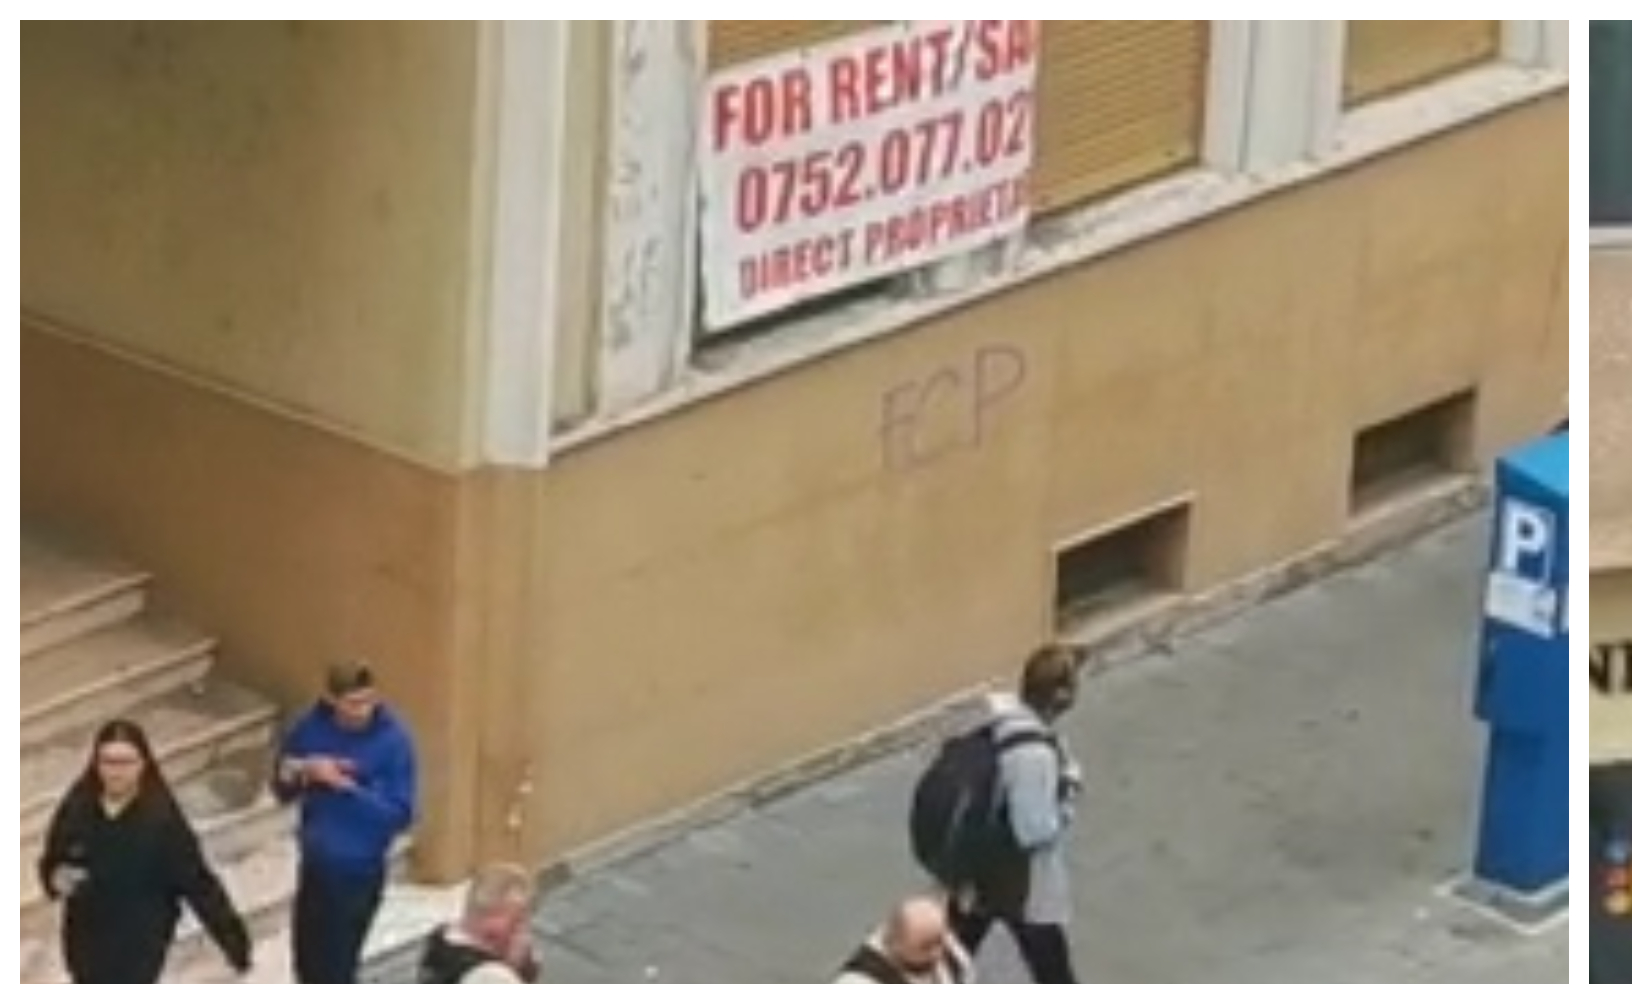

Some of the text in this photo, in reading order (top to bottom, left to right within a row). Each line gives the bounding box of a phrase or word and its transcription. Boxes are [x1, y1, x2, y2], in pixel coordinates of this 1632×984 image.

[713, 68, 811, 152] FOR
[735, 90, 1032, 233] 0752.077.02
[738, 229, 854, 299] DIRECT
[1505, 500, 1547, 572] P
